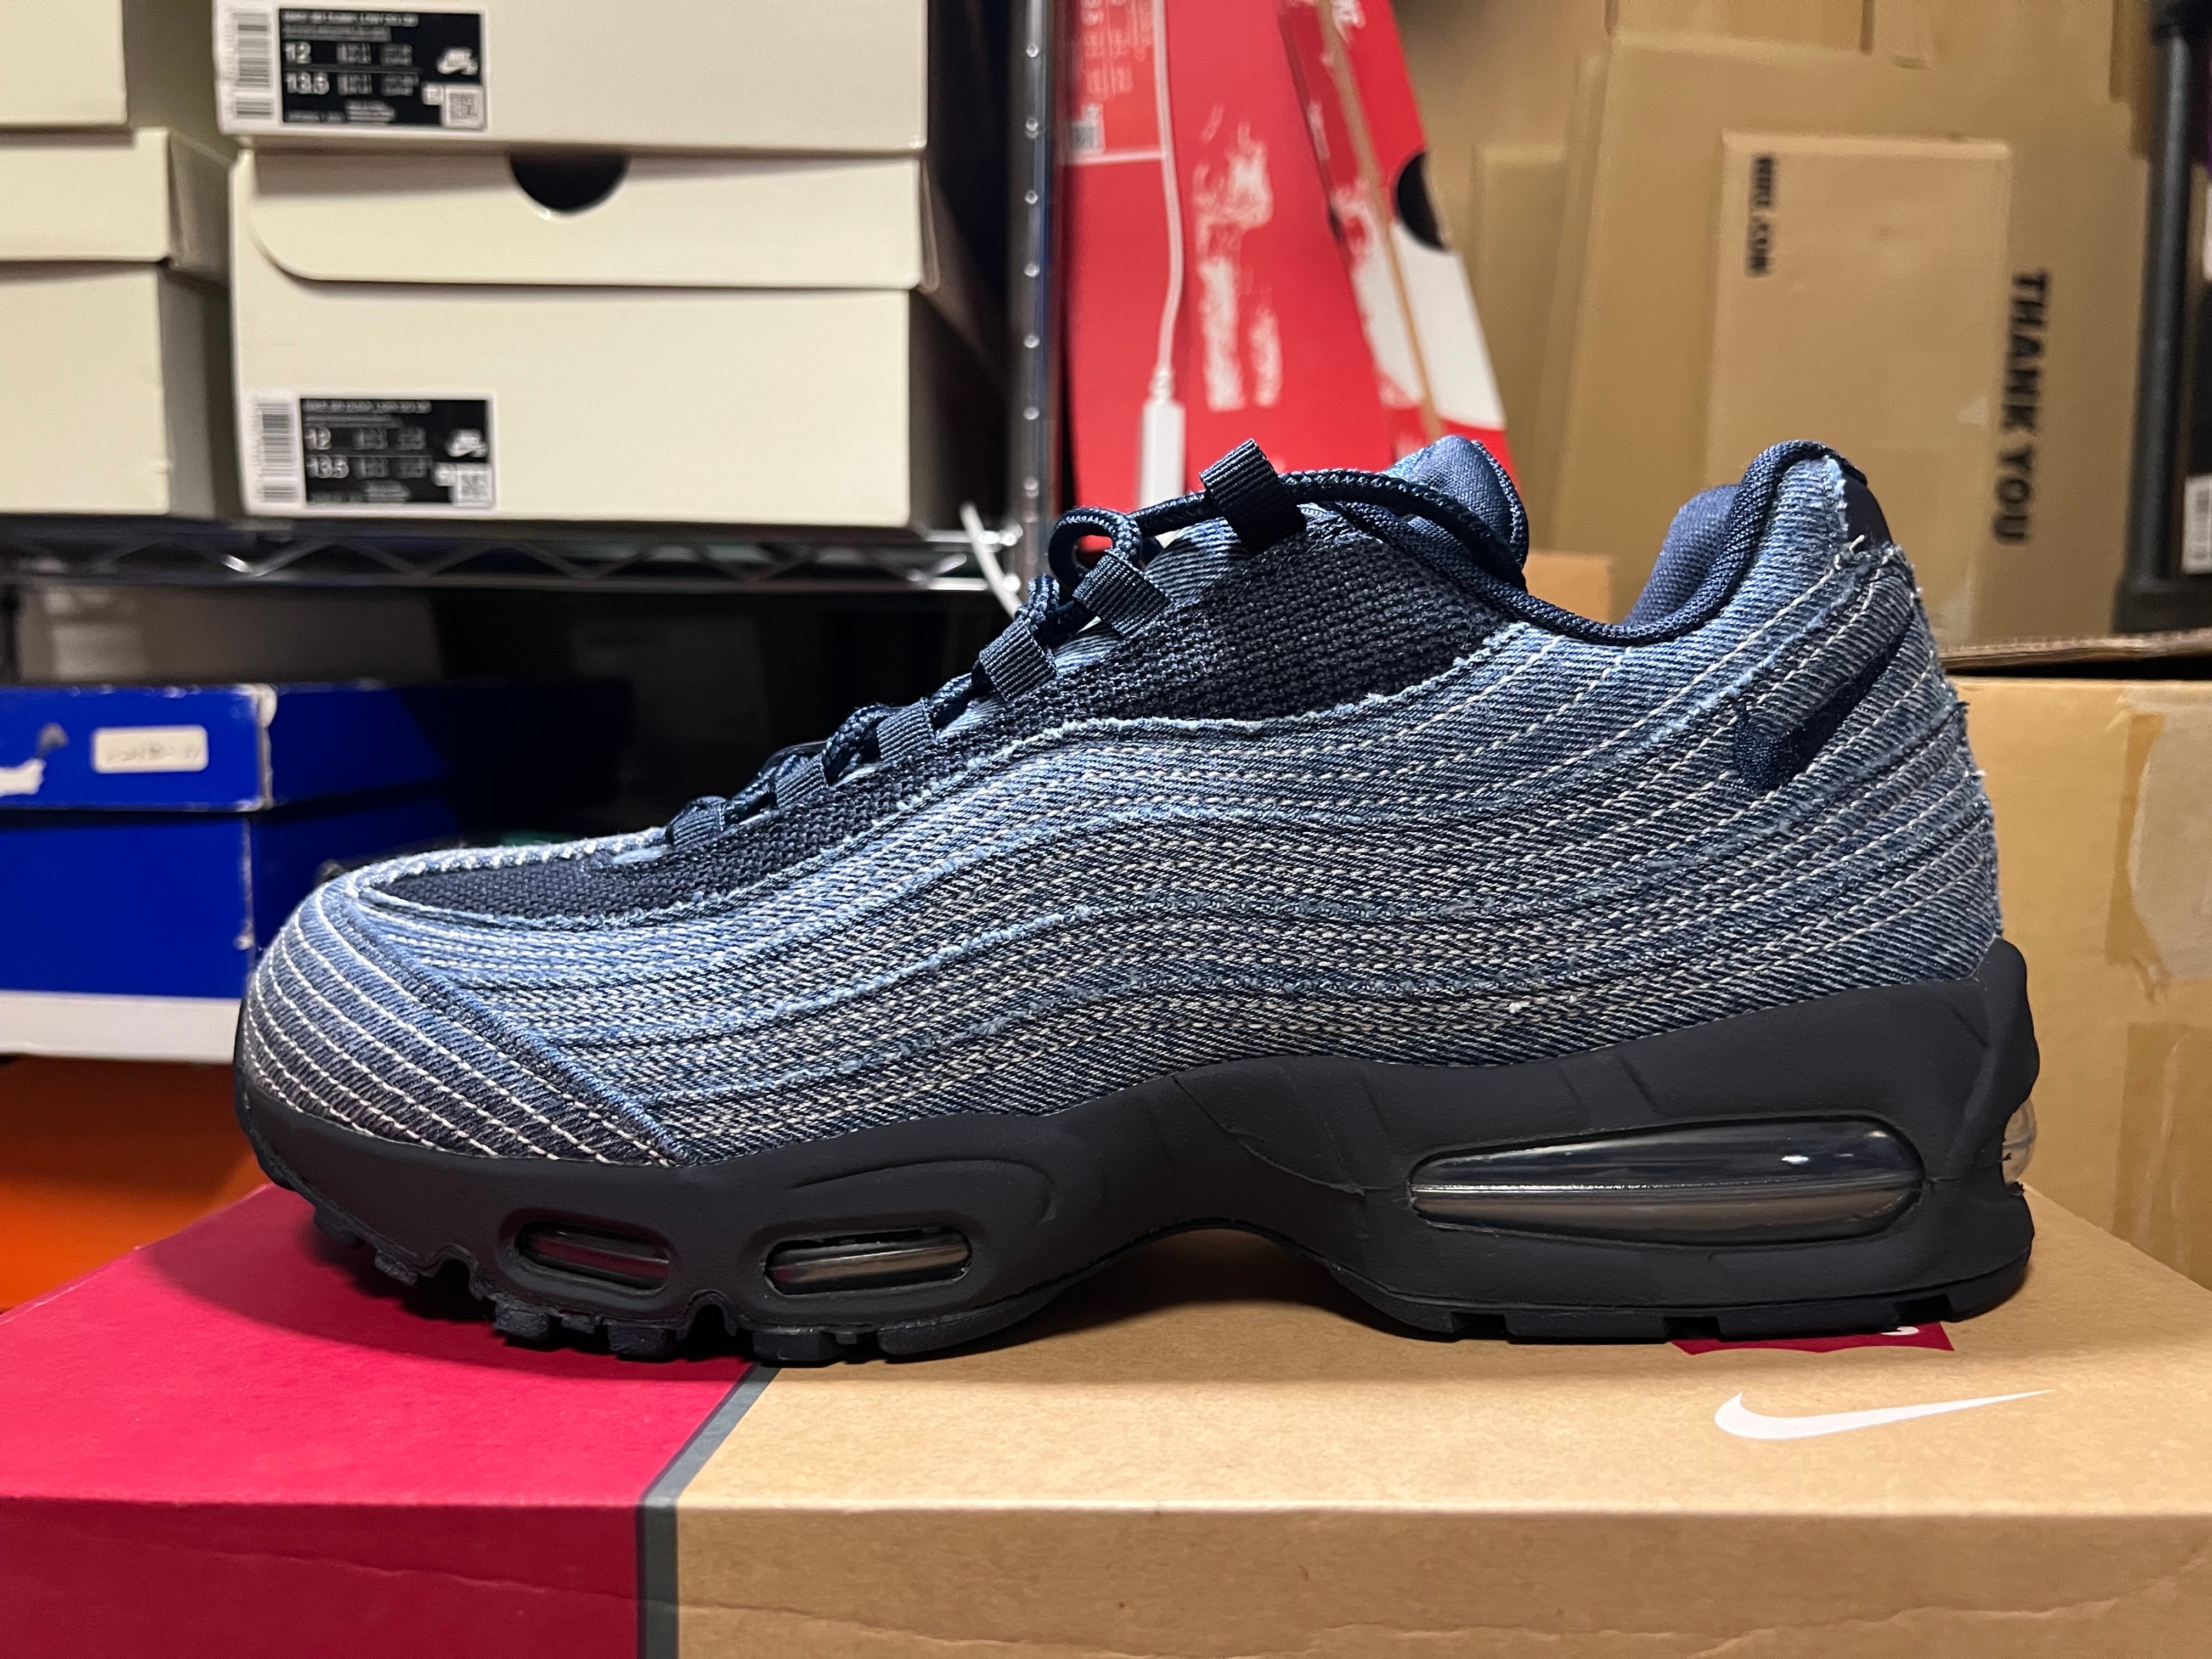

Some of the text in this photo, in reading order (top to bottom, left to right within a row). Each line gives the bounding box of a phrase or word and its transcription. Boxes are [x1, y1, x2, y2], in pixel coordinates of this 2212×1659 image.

[284, 42, 311, 64] 12
[1994, 269, 2050, 543] THANK YOU
[305, 427, 331, 450] 12
